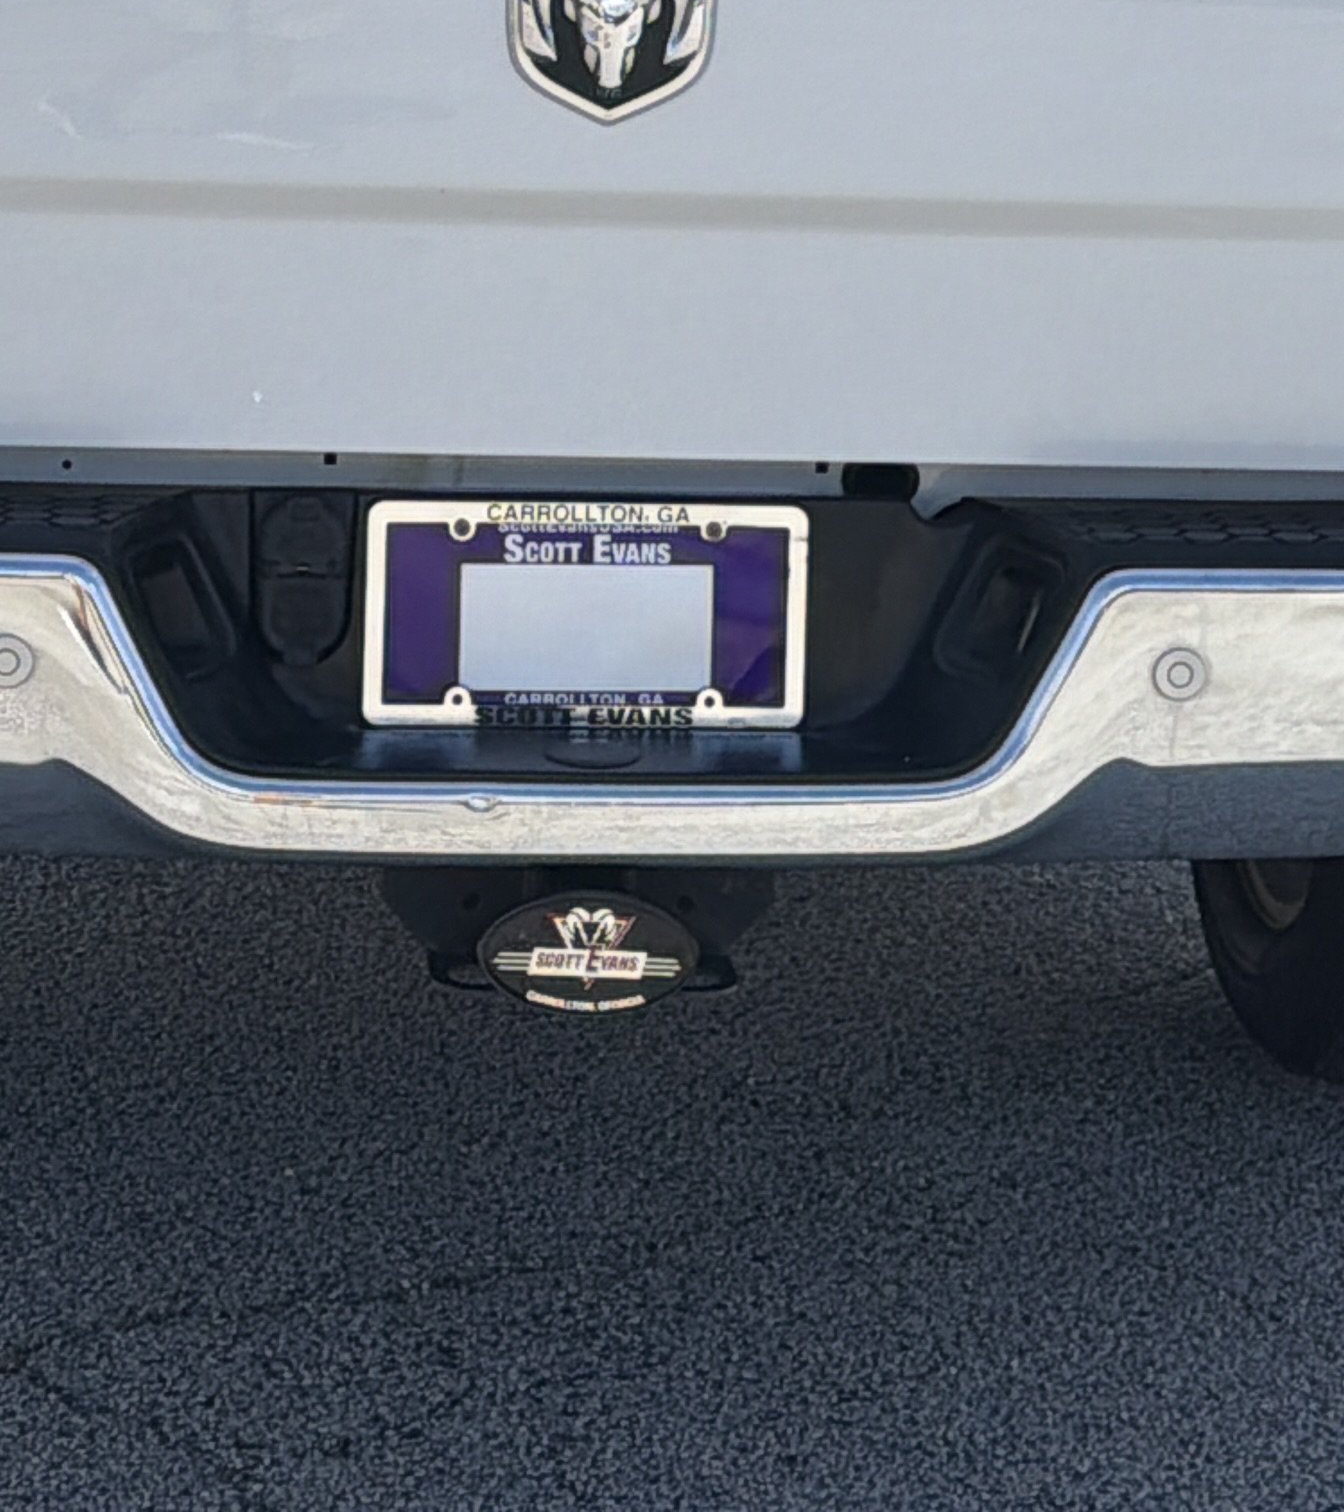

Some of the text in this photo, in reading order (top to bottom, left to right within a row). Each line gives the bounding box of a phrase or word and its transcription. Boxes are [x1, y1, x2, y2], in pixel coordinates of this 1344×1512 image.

[657, 506, 690, 523] GA
[504, 534, 672, 564] SCOTT EVANS
[638, 693, 664, 705] GA
[474, 706, 694, 726] SCOTT EVANS
[536, 945, 640, 972] SCOTT EVANS
